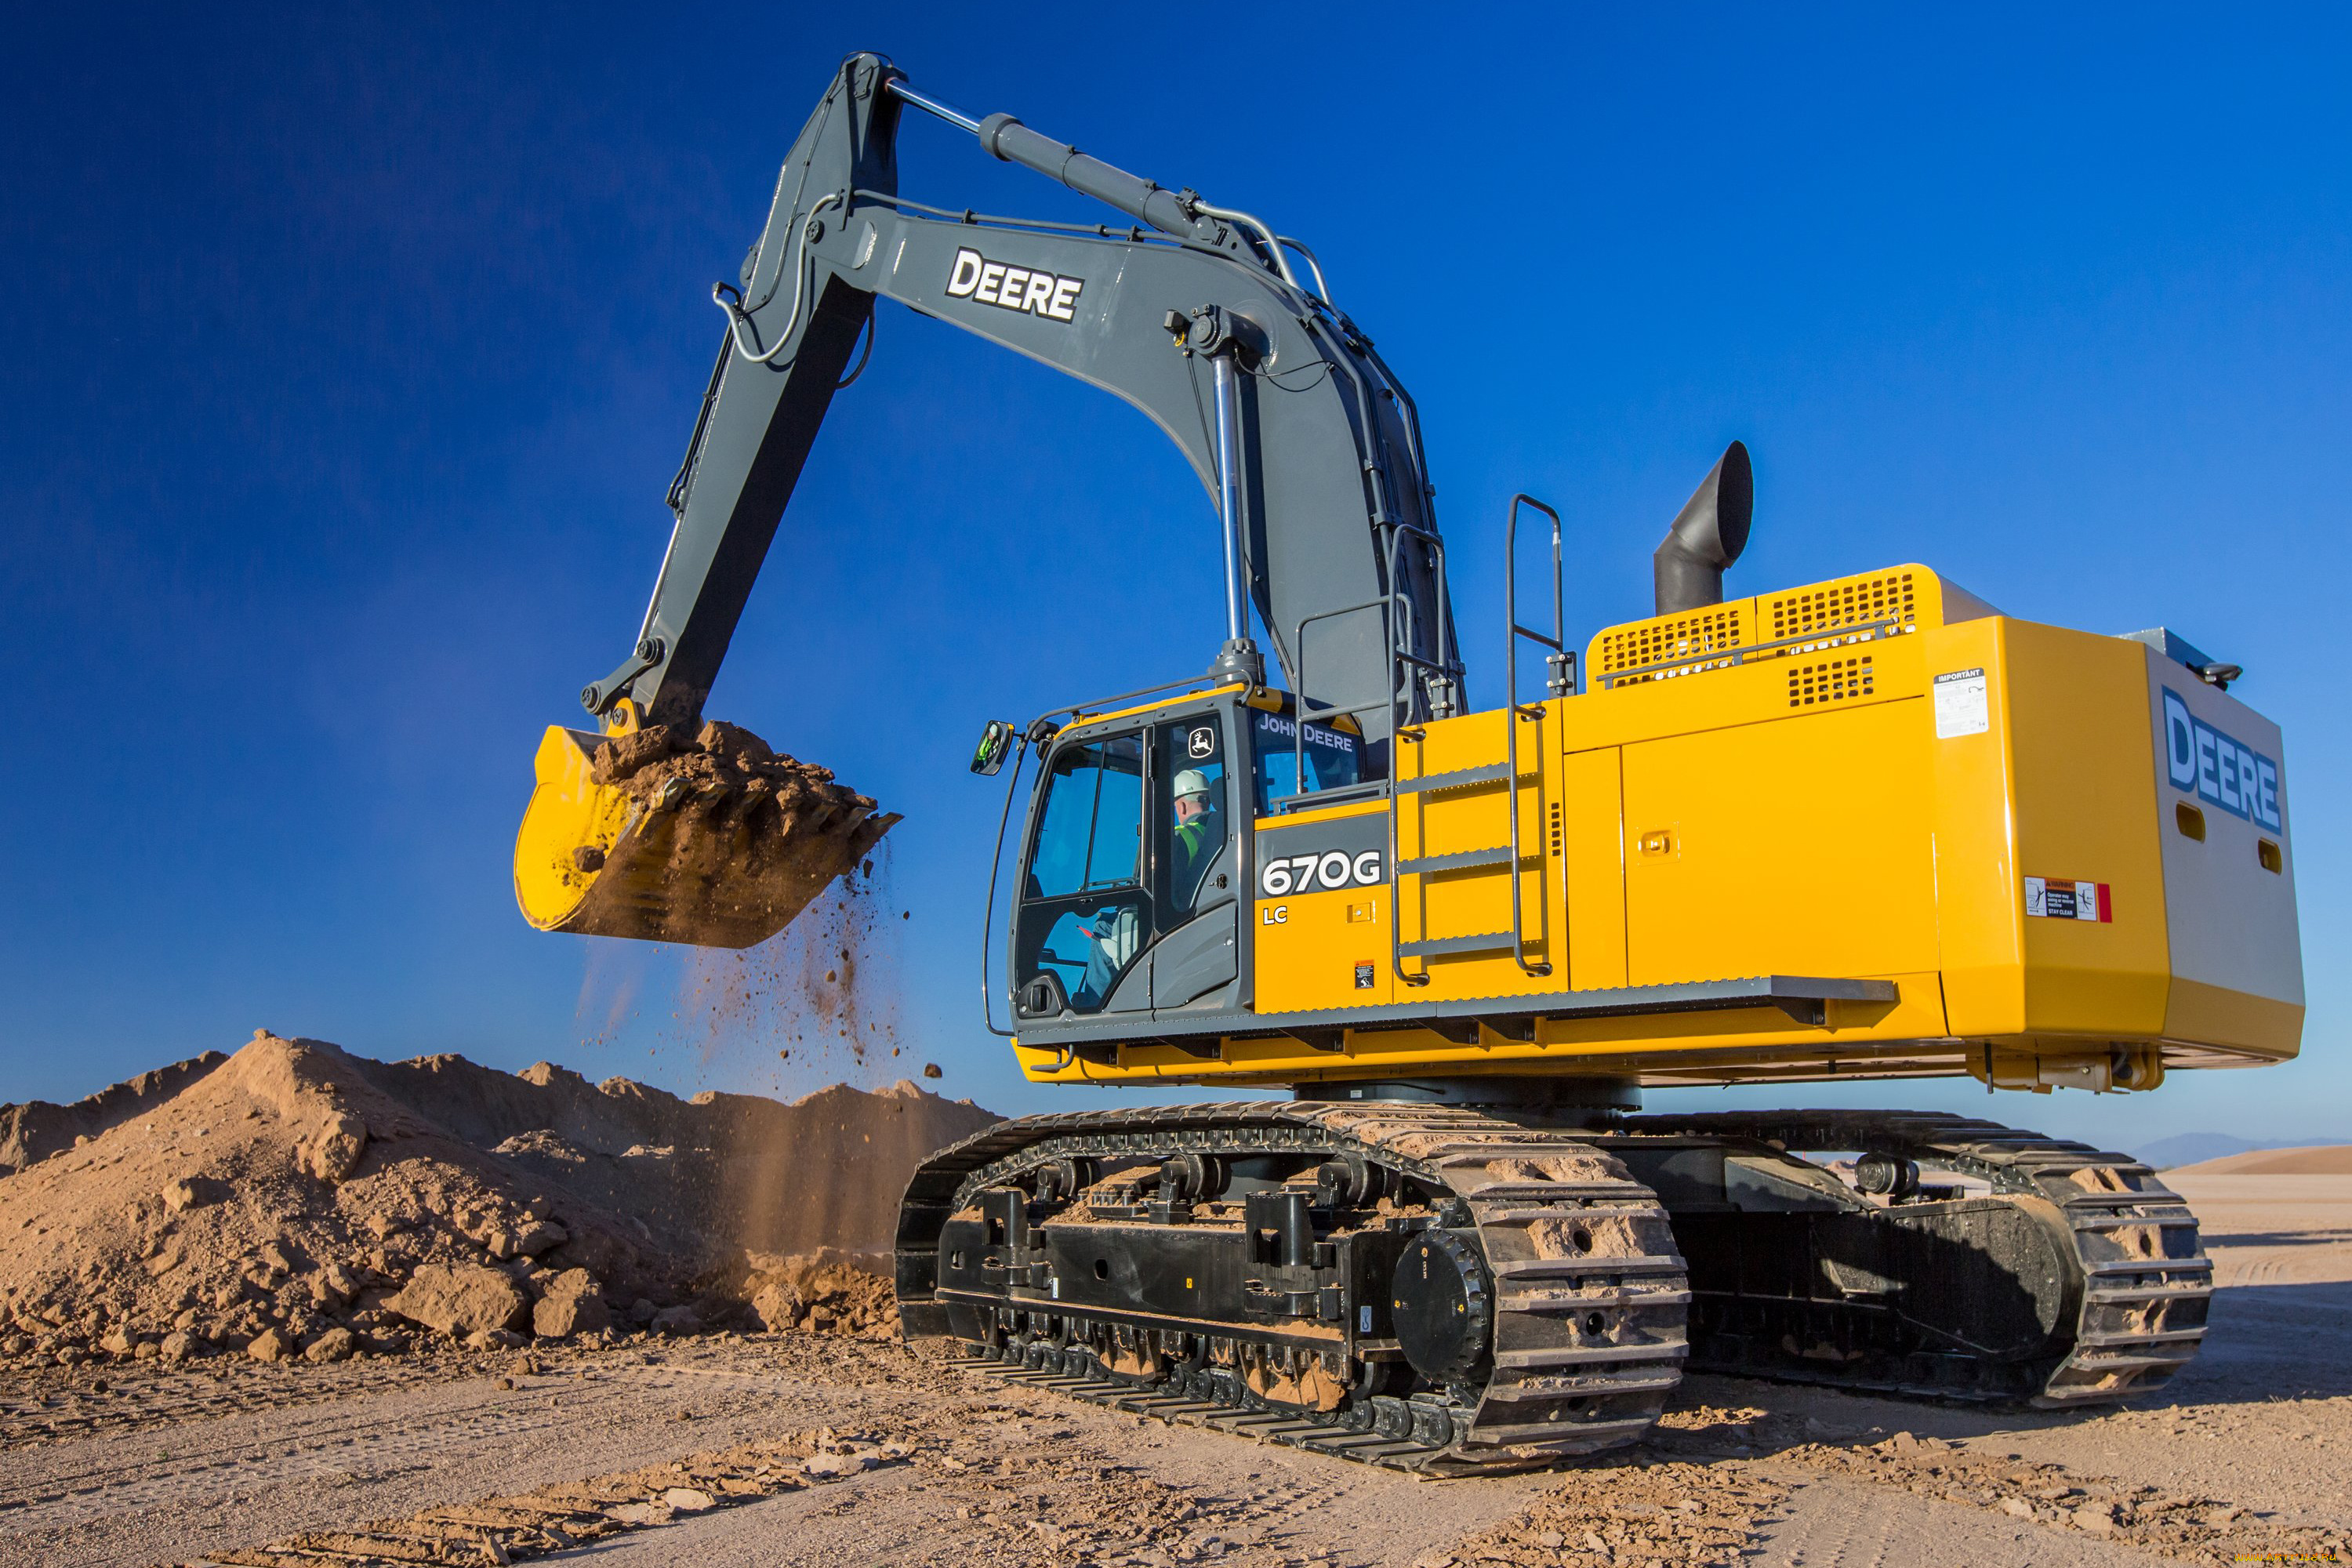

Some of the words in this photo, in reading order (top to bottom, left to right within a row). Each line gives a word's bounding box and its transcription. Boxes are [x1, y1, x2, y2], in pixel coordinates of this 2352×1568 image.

[946, 249, 1083, 321] DEERE
[1938, 669, 1980, 682] IMPORTANT
[1260, 713, 1298, 737] JOHN
[1304, 724, 1352, 752] DEERE
[2164, 694, 2280, 829] DEERE
[1262, 851, 1380, 896] 670G
[1263, 906, 1287, 924] LC
